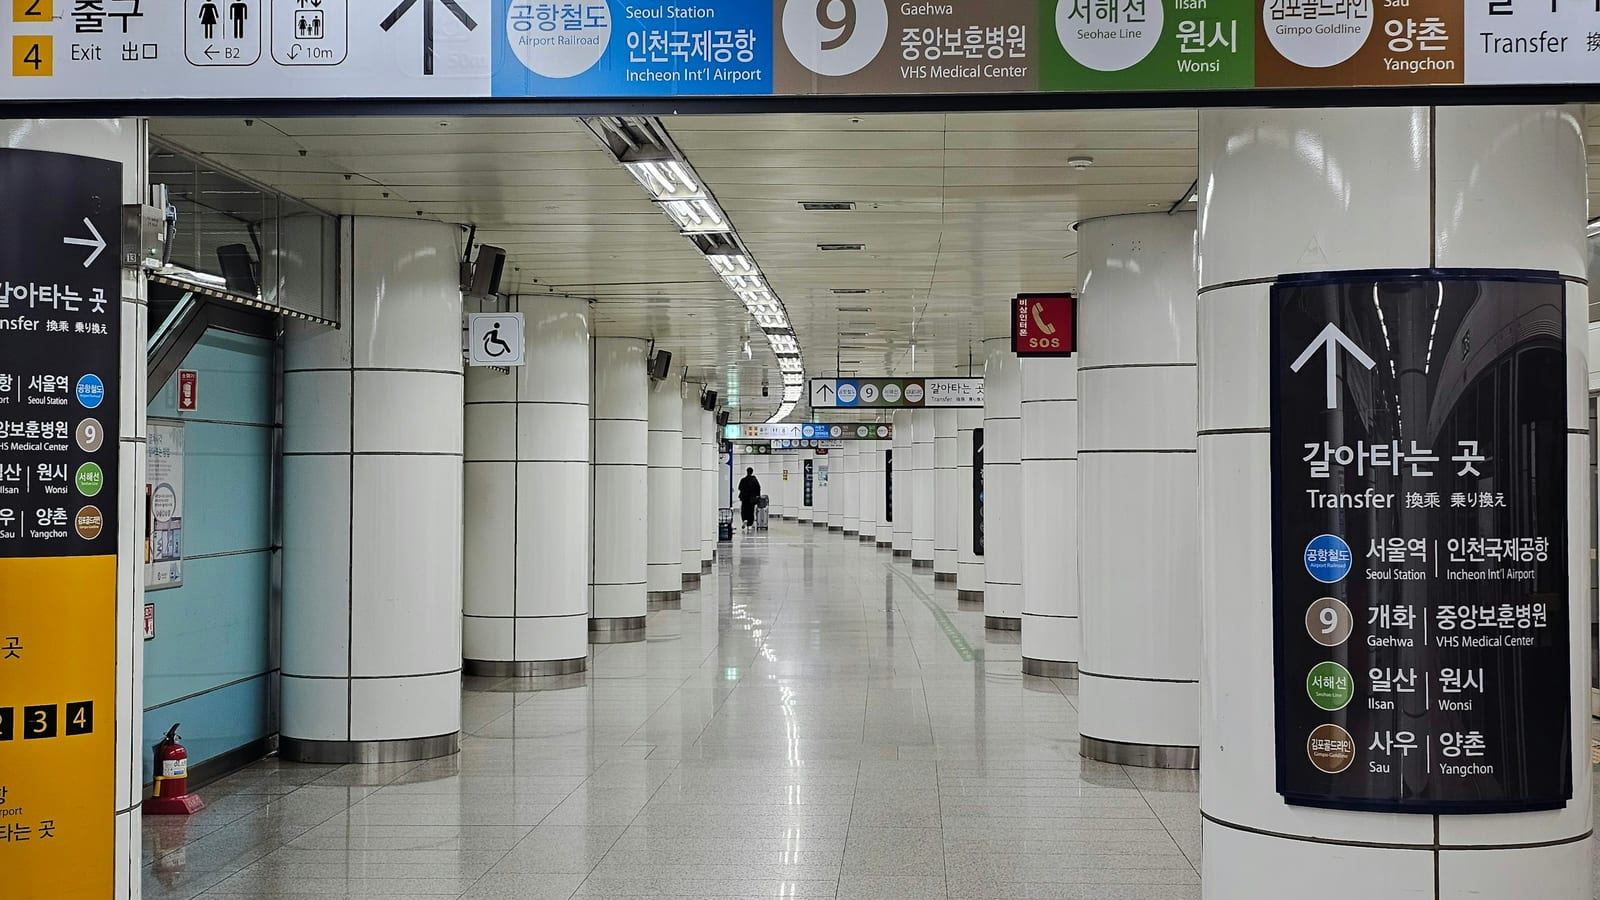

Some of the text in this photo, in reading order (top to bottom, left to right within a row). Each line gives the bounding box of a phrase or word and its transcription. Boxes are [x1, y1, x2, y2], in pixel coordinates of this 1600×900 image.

[510, 0, 608, 32] 공항철도
[626, 6, 714, 18] Seoul Station
[901, 3, 953, 16] Gaehwa
[1068, 0, 1146, 24] 서해선
[815, 0, 857, 50] 9
[1077, 28, 1142, 40] Seohae Line
[1276, 24, 1361, 36] Gimpo Goldline
[519, 35, 600, 48] Airport Railroad
[900, 25, 1027, 61] 중앙보훈병원
[1176, 20, 1237, 53] 원시
[1384, 17, 1449, 52] 양촌
[1480, 31, 1568, 53] Transfer
[71, 43, 102, 61] Exit
[122, 41, 158, 61] 出口
[225, 47, 241, 59] B2
[307, 47, 333, 59] 10m
[626, 29, 755, 63] 인천국제공항
[23, 43, 42, 70] 4
[1384, 57, 1455, 73] Yangchon
[900, 65, 1028, 79] VHS Medical Center
[1177, 59, 1220, 73] Wonsi
[626, 69, 681, 82] Incheon
[713, 68, 762, 83] Airport
[88, 287, 107, 314] 곳
[1029, 337, 1060, 348] SOS
[28, 374, 69, 393] 서울역
[865, 387, 873, 398] 9
[930, 383, 972, 395] 갈아타는
[27, 395, 68, 406] Seoul Station
[85, 425, 96, 443] 9
[10, 441, 43, 451] Medical
[43, 442, 69, 451] Center
[1302, 439, 1486, 478] 갈아타는 곳
[0, 463, 22, 481] 산
[36, 463, 68, 482] 원시
[44, 485, 68, 494] Wonsi
[1306, 488, 1395, 509] Transfer
[36, 507, 68, 526] 양촌
[30, 529, 68, 540] Yangchon
[1306, 549, 1350, 562] 공항철도
[1366, 537, 1426, 563] 서울역
[1447, 536, 1549, 563] 인천국제공항
[1366, 568, 1426, 580] Seoul Station
[1447, 569, 1486, 581] Incheon
[1506, 569, 1535, 582] Airport
[1319, 607, 1338, 634] 9
[1367, 604, 1416, 630] 개화
[1436, 602, 1547, 630] 중앙보훈병원
[1, 636, 23, 659] 곳
[1367, 636, 1414, 647] Gaehwa
[1436, 635, 1535, 648] VHS Medical Center
[1312, 675, 1347, 690] 서해선
[1368, 667, 1417, 693] 일산
[1439, 667, 1484, 693] 원시
[1368, 698, 1395, 710] Ilsan
[1439, 699, 1473, 711] Wonsi
[33, 706, 86, 733] 3 4
[1311, 738, 1351, 753] 김포골드라인
[1369, 730, 1418, 757] 사우
[1440, 731, 1486, 757] 양촌
[1369, 761, 1390, 773] Sau
[1440, 763, 1494, 777] Yangchon
[38, 820, 56, 839] 곳
